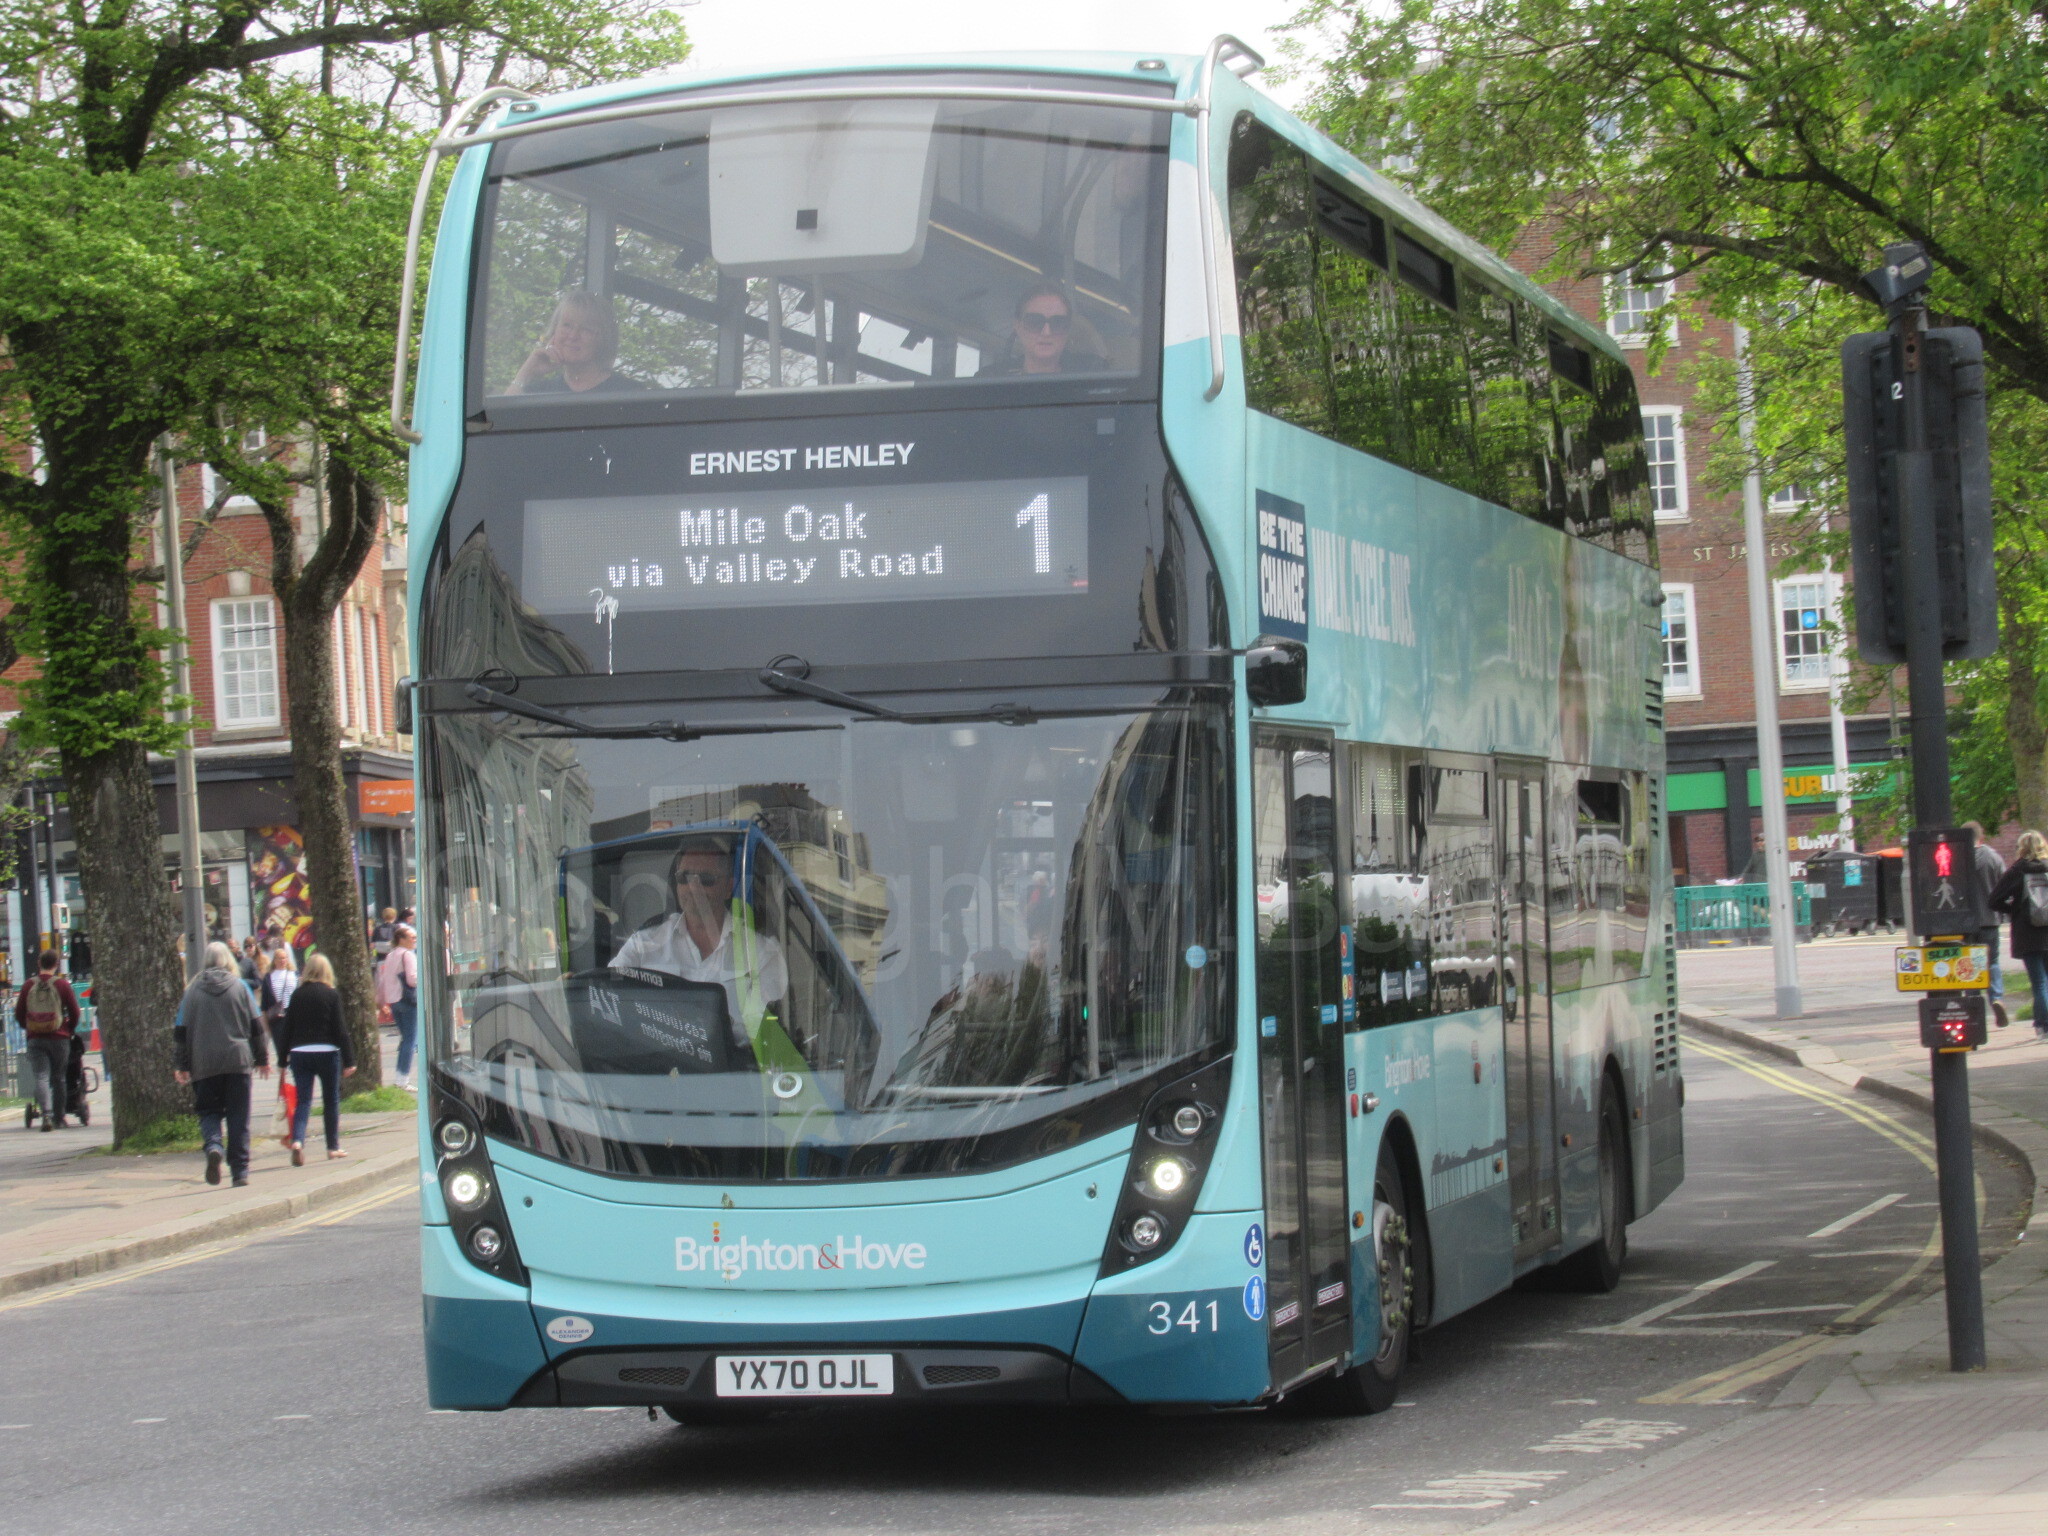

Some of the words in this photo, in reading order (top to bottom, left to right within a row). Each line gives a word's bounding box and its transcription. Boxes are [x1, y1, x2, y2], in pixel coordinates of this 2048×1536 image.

[1891, 381, 1903, 400] 2
[690, 448, 796, 475] ERNEST
[804, 442, 915, 470] HENLEY
[679, 507, 766, 547] Mile
[784, 503, 868, 541] Oak
[1016, 494, 1051, 575] 1
[1259, 510, 1276, 548] BE
[1277, 516, 1304, 556] THE
[608, 560, 664, 588] via
[686, 552, 816, 587] Valley
[840, 546, 945, 579] Road
[1693, 547, 1714, 562] ST
[1260, 552, 1306, 624] CHANGE
[1928, 947, 1960, 960] SLAX
[1903, 974, 1940, 986] BOTH
[1947, 973, 1984, 983] WS
[1147, 1300, 1220, 1336] 341
[729, 1360, 810, 1390] YX70
[818, 1359, 878, 1389] OJL
